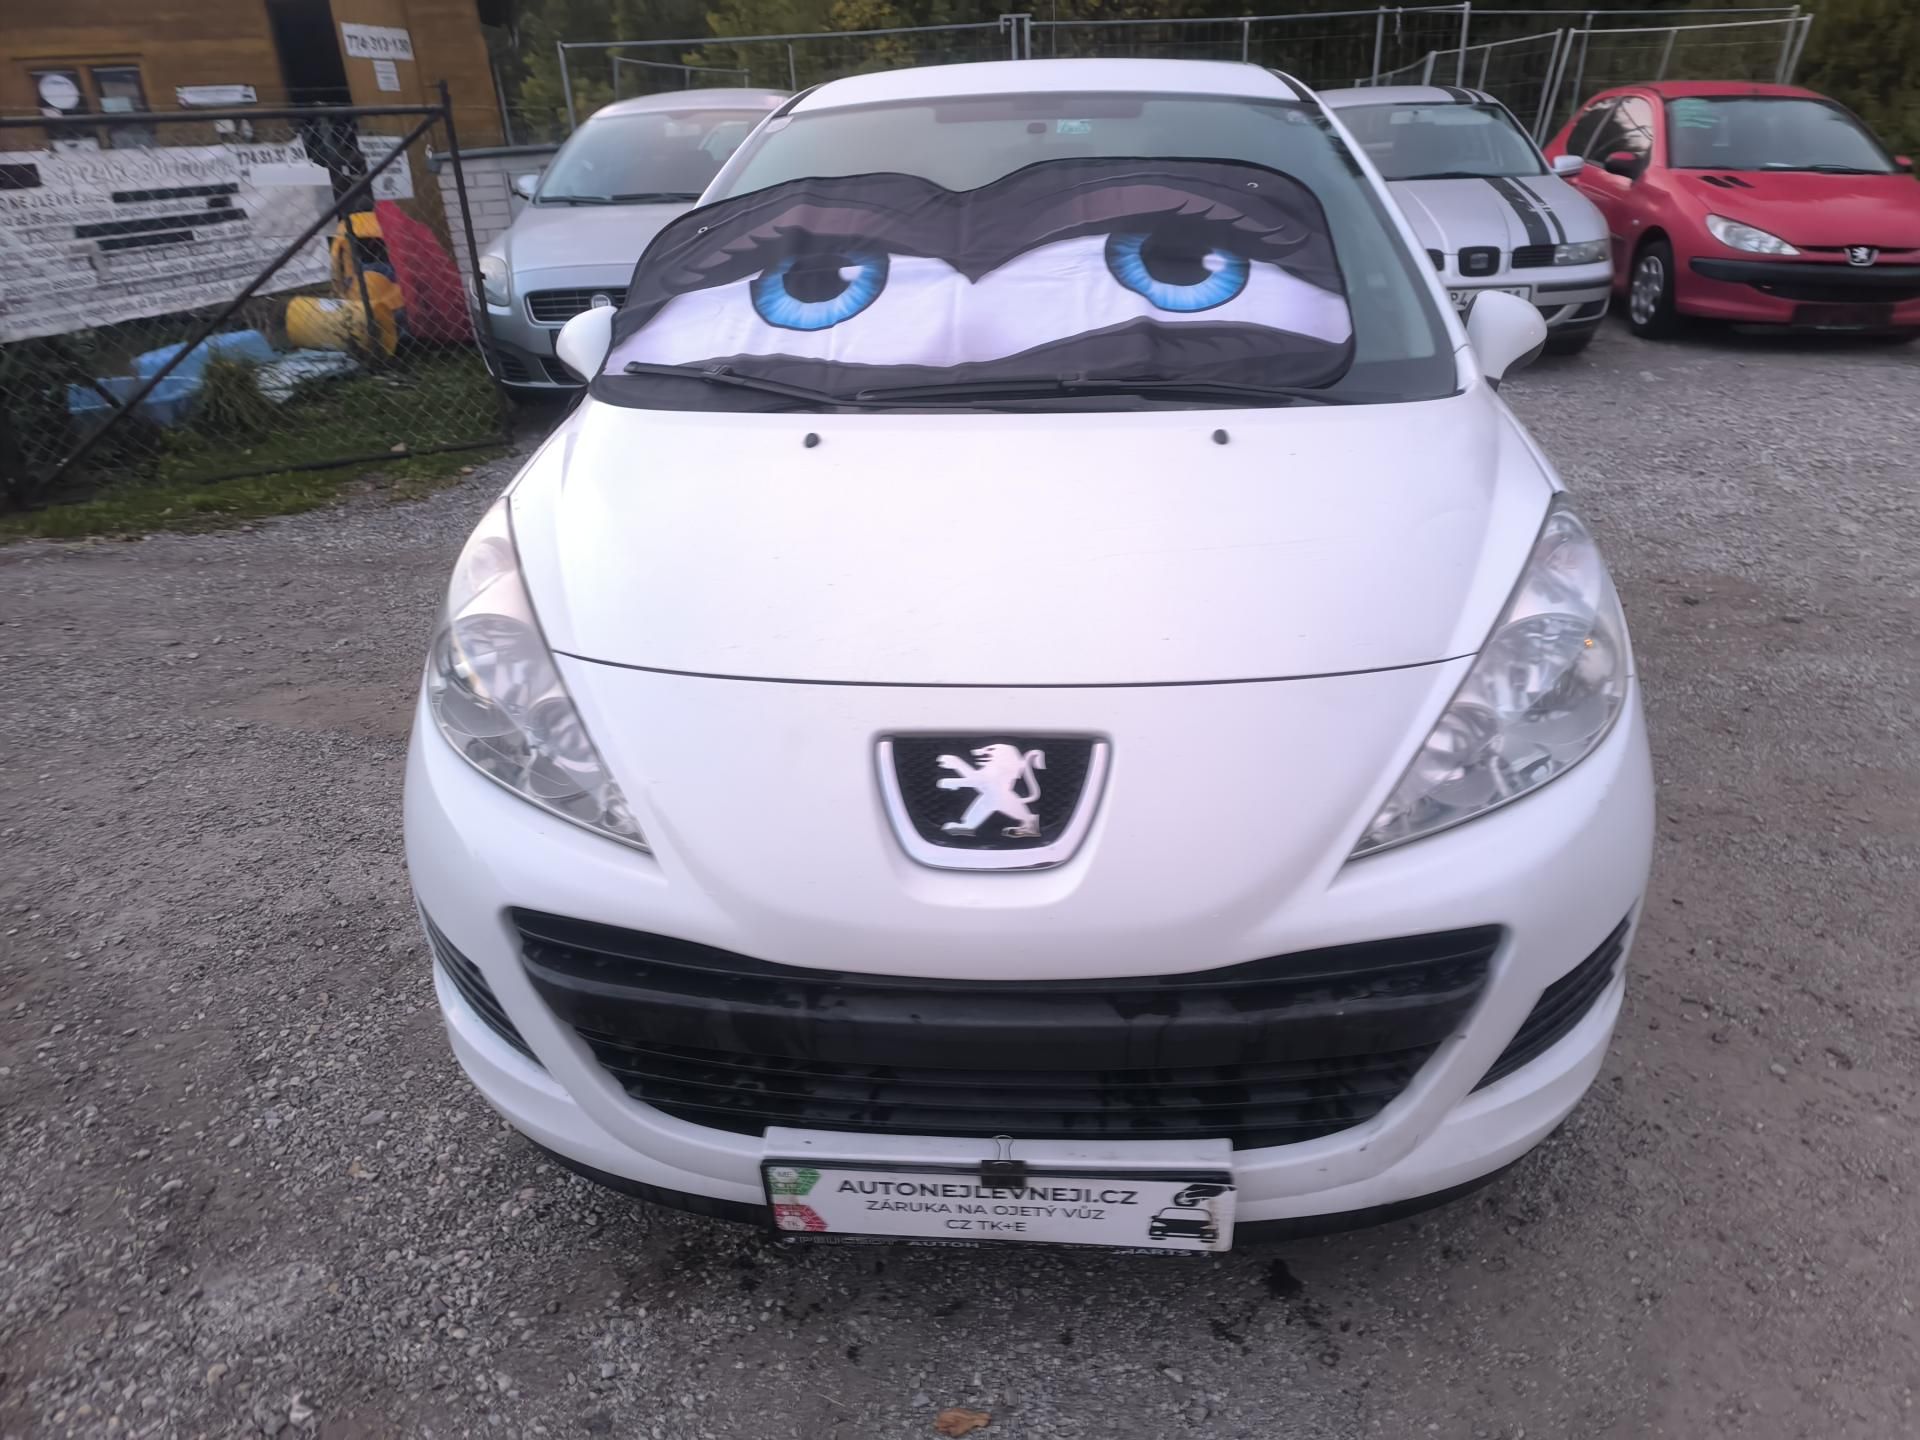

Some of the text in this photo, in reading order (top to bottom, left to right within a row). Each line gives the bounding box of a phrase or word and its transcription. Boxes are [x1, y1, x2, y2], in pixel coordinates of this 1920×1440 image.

[838, 1179, 1138, 1205] AUTONEJLEVNEJI.CZ
[865, 1199, 1105, 1220] ZÁRUKA NA OJETÝ VŮZ
[945, 1218, 1028, 1232] CZ TK+E
